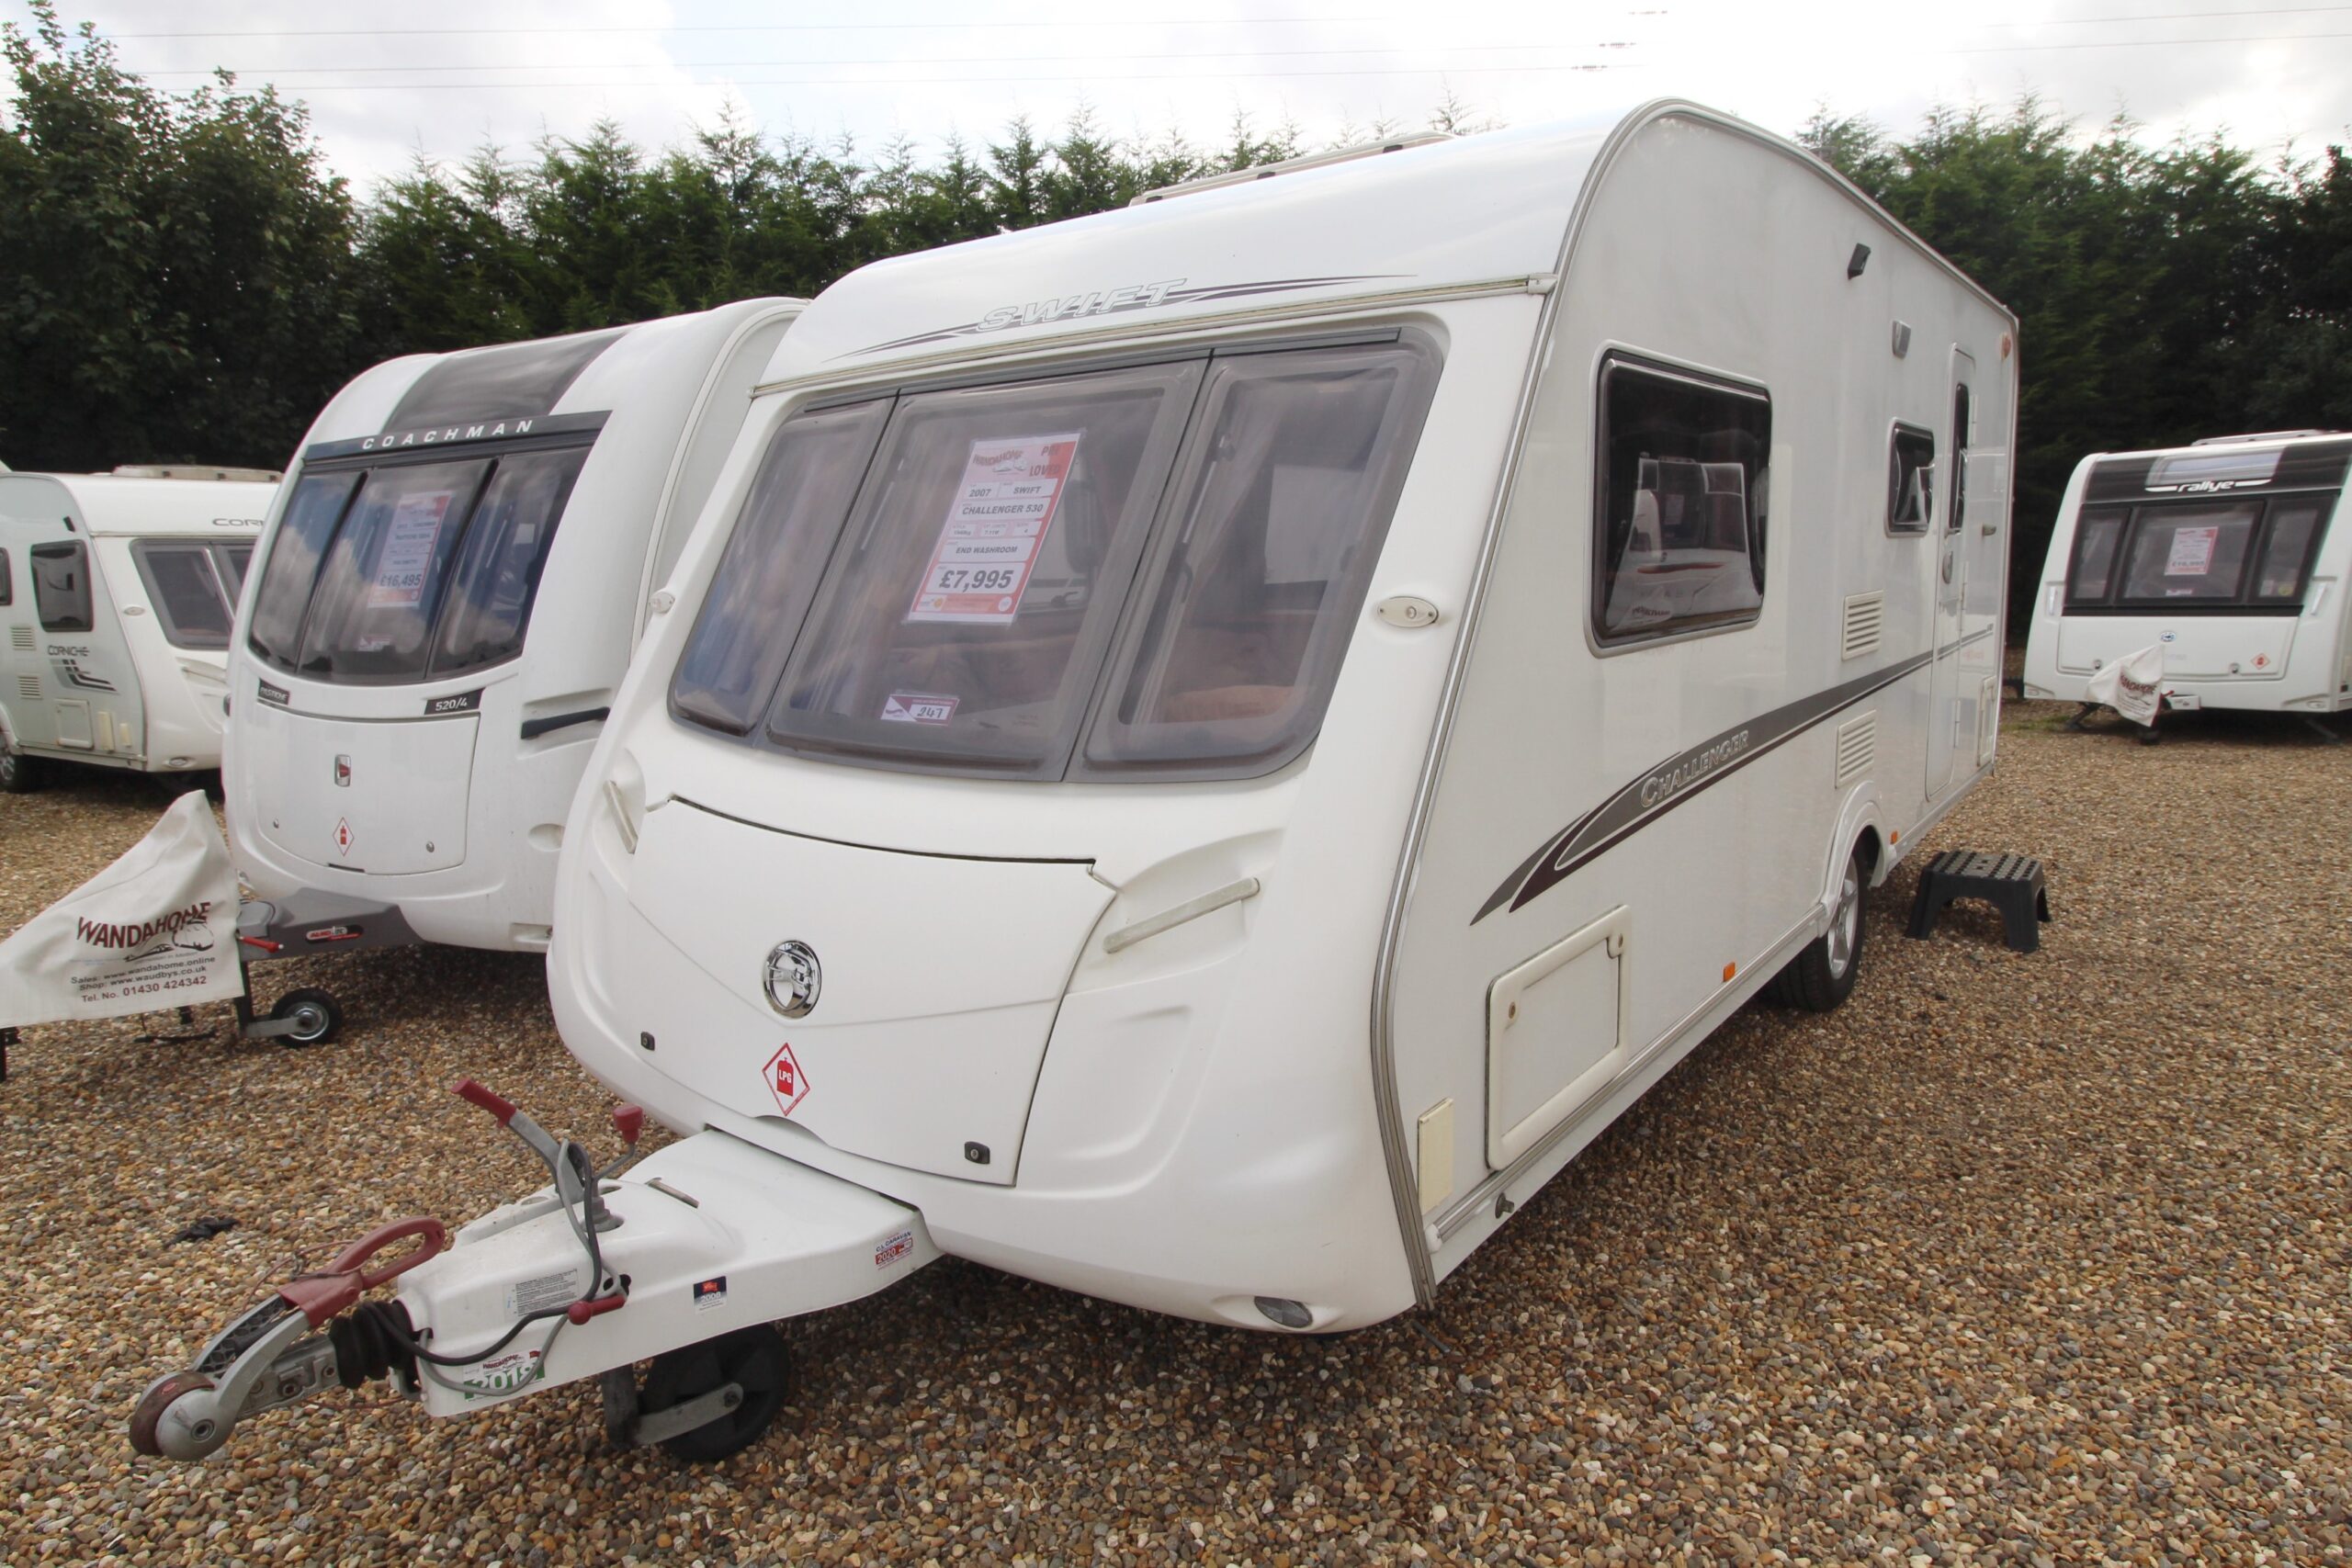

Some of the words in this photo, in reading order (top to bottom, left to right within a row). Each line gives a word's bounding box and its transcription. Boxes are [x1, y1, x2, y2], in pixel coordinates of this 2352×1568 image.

[976, 277, 1188, 333] SWIFT
[362, 420, 533, 450] COACHMAN
[968, 489, 992, 498] 2007
[1012, 486, 1042, 495] SWIFT
[2177, 480, 2235, 492] rallye
[962, 504, 1023, 515] CHALLENGER
[1025, 503, 1044, 513] 530
[973, 546, 1018, 554] WASHROOM
[379, 573, 422, 588] £16,495
[939, 570, 1014, 592] £7,995
[435, 696, 468, 711] 520/4
[1640, 729, 1749, 808] CHALLENGER
[76, 901, 211, 949] WANDAHOME
[122, 982, 160, 998] 01430
[164, 976, 207, 990] 424342
[778, 1069, 792, 1084] LPG
[876, 1247, 897, 1264] 2020
